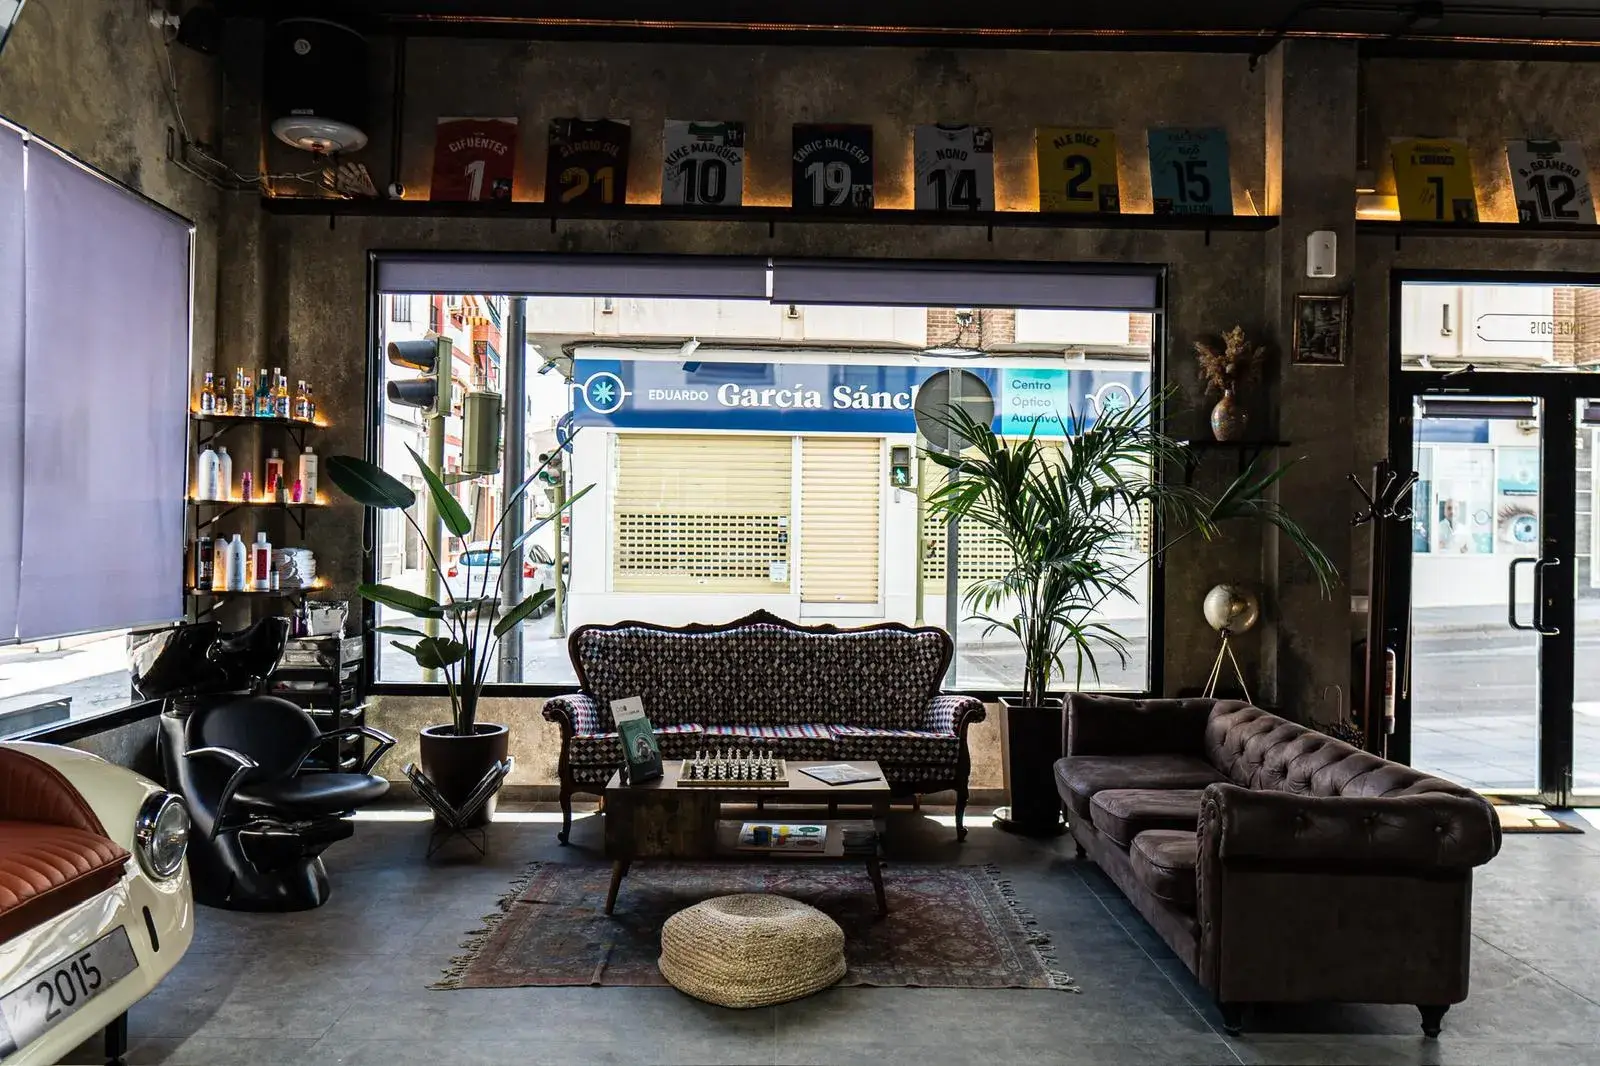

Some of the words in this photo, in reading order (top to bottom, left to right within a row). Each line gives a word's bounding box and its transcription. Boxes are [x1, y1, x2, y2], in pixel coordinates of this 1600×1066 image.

[449, 137, 508, 156] CIFUENTES
[559, 139, 601, 159] SERGIO
[793, 140, 823, 162] ENRIC
[825, 138, 870, 164] GALLEGO
[936, 148, 968, 162] NONO
[1053, 133, 1074, 149] ALE
[465, 160, 486, 200] 1
[559, 165, 615, 204] 21
[680, 158, 727, 204] 10
[804, 161, 852, 207] 19
[1063, 153, 1094, 199] 2
[1172, 160, 1211, 203] 15
[1530, 159, 1581, 178] GRANERO
[927, 168, 982, 212] 14
[1427, 177, 1444, 220] 1
[1527, 174, 1580, 219] 12
[648, 389, 709, 401] EDUARDO
[717, 383, 822, 408] García
[1011, 379, 1051, 390] Centro
[36, 952, 102, 1022] 2015
